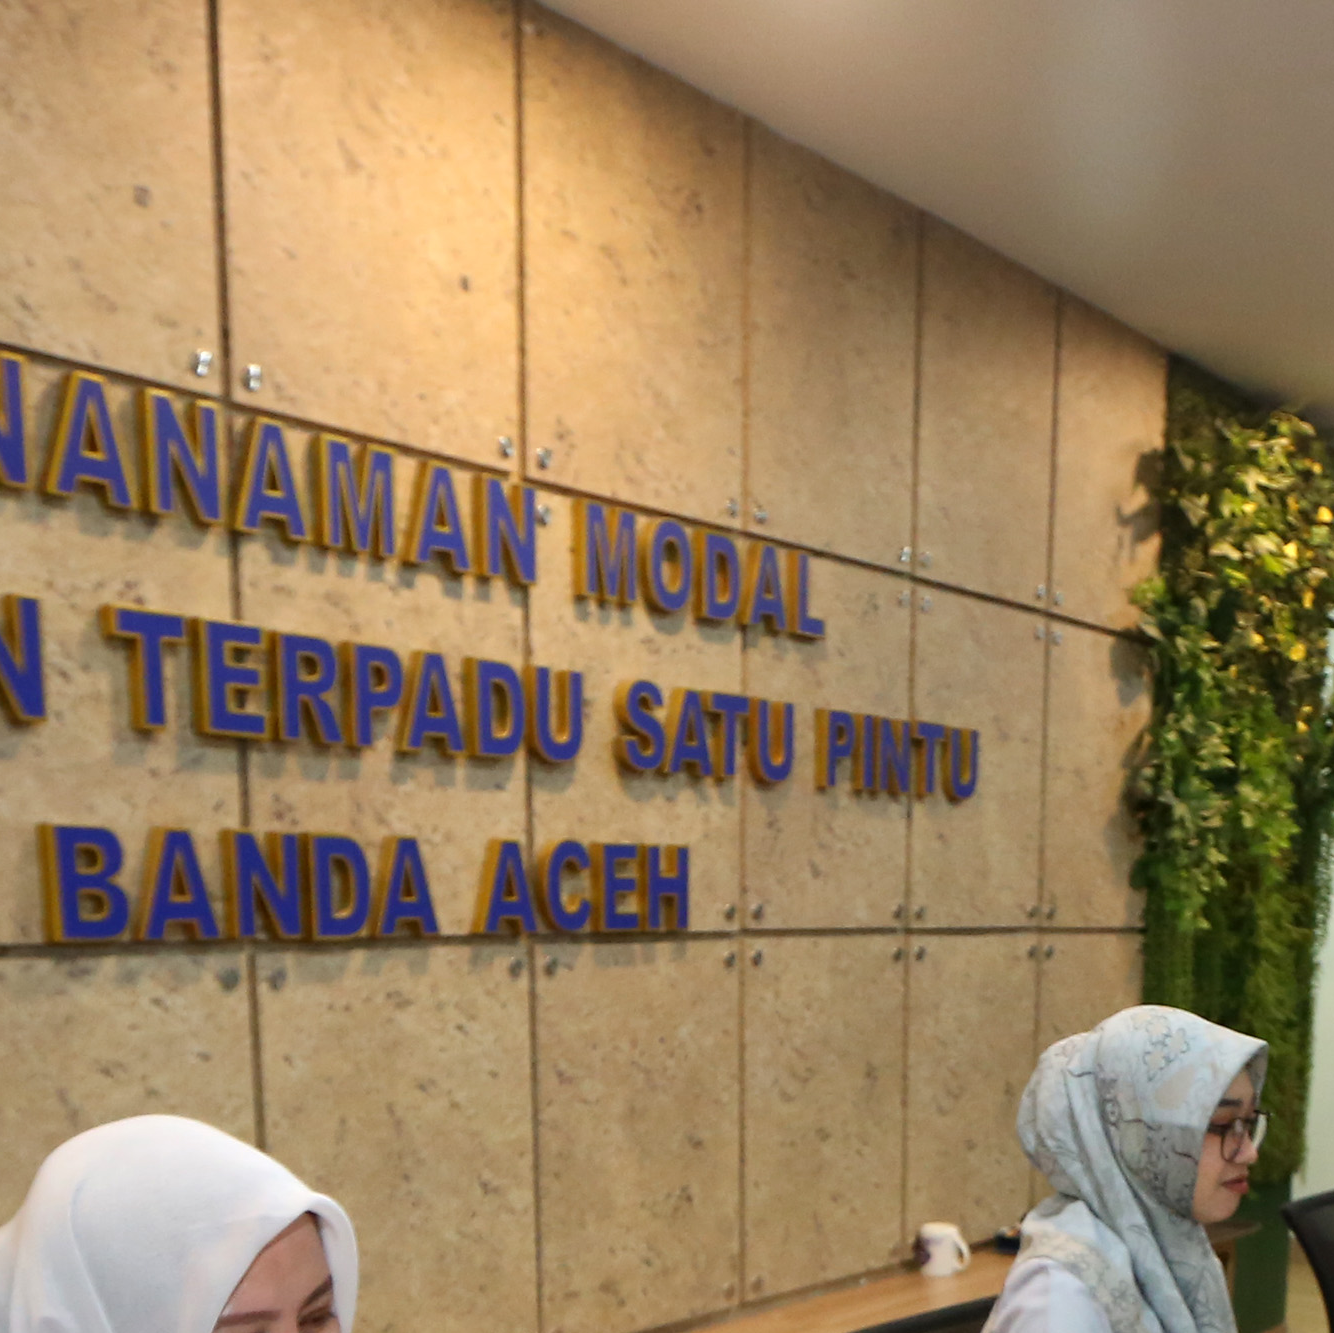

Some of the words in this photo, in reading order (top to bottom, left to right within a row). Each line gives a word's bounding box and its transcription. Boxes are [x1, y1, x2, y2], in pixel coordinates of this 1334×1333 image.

[573, 497, 825, 638] MODAL
[102, 604, 584, 762] TERPADU
[614, 680, 795, 783] SATU
[814, 707, 980, 801] PINTU
[38, 822, 439, 943] BANDA
[473, 838, 689, 935] ACEH
